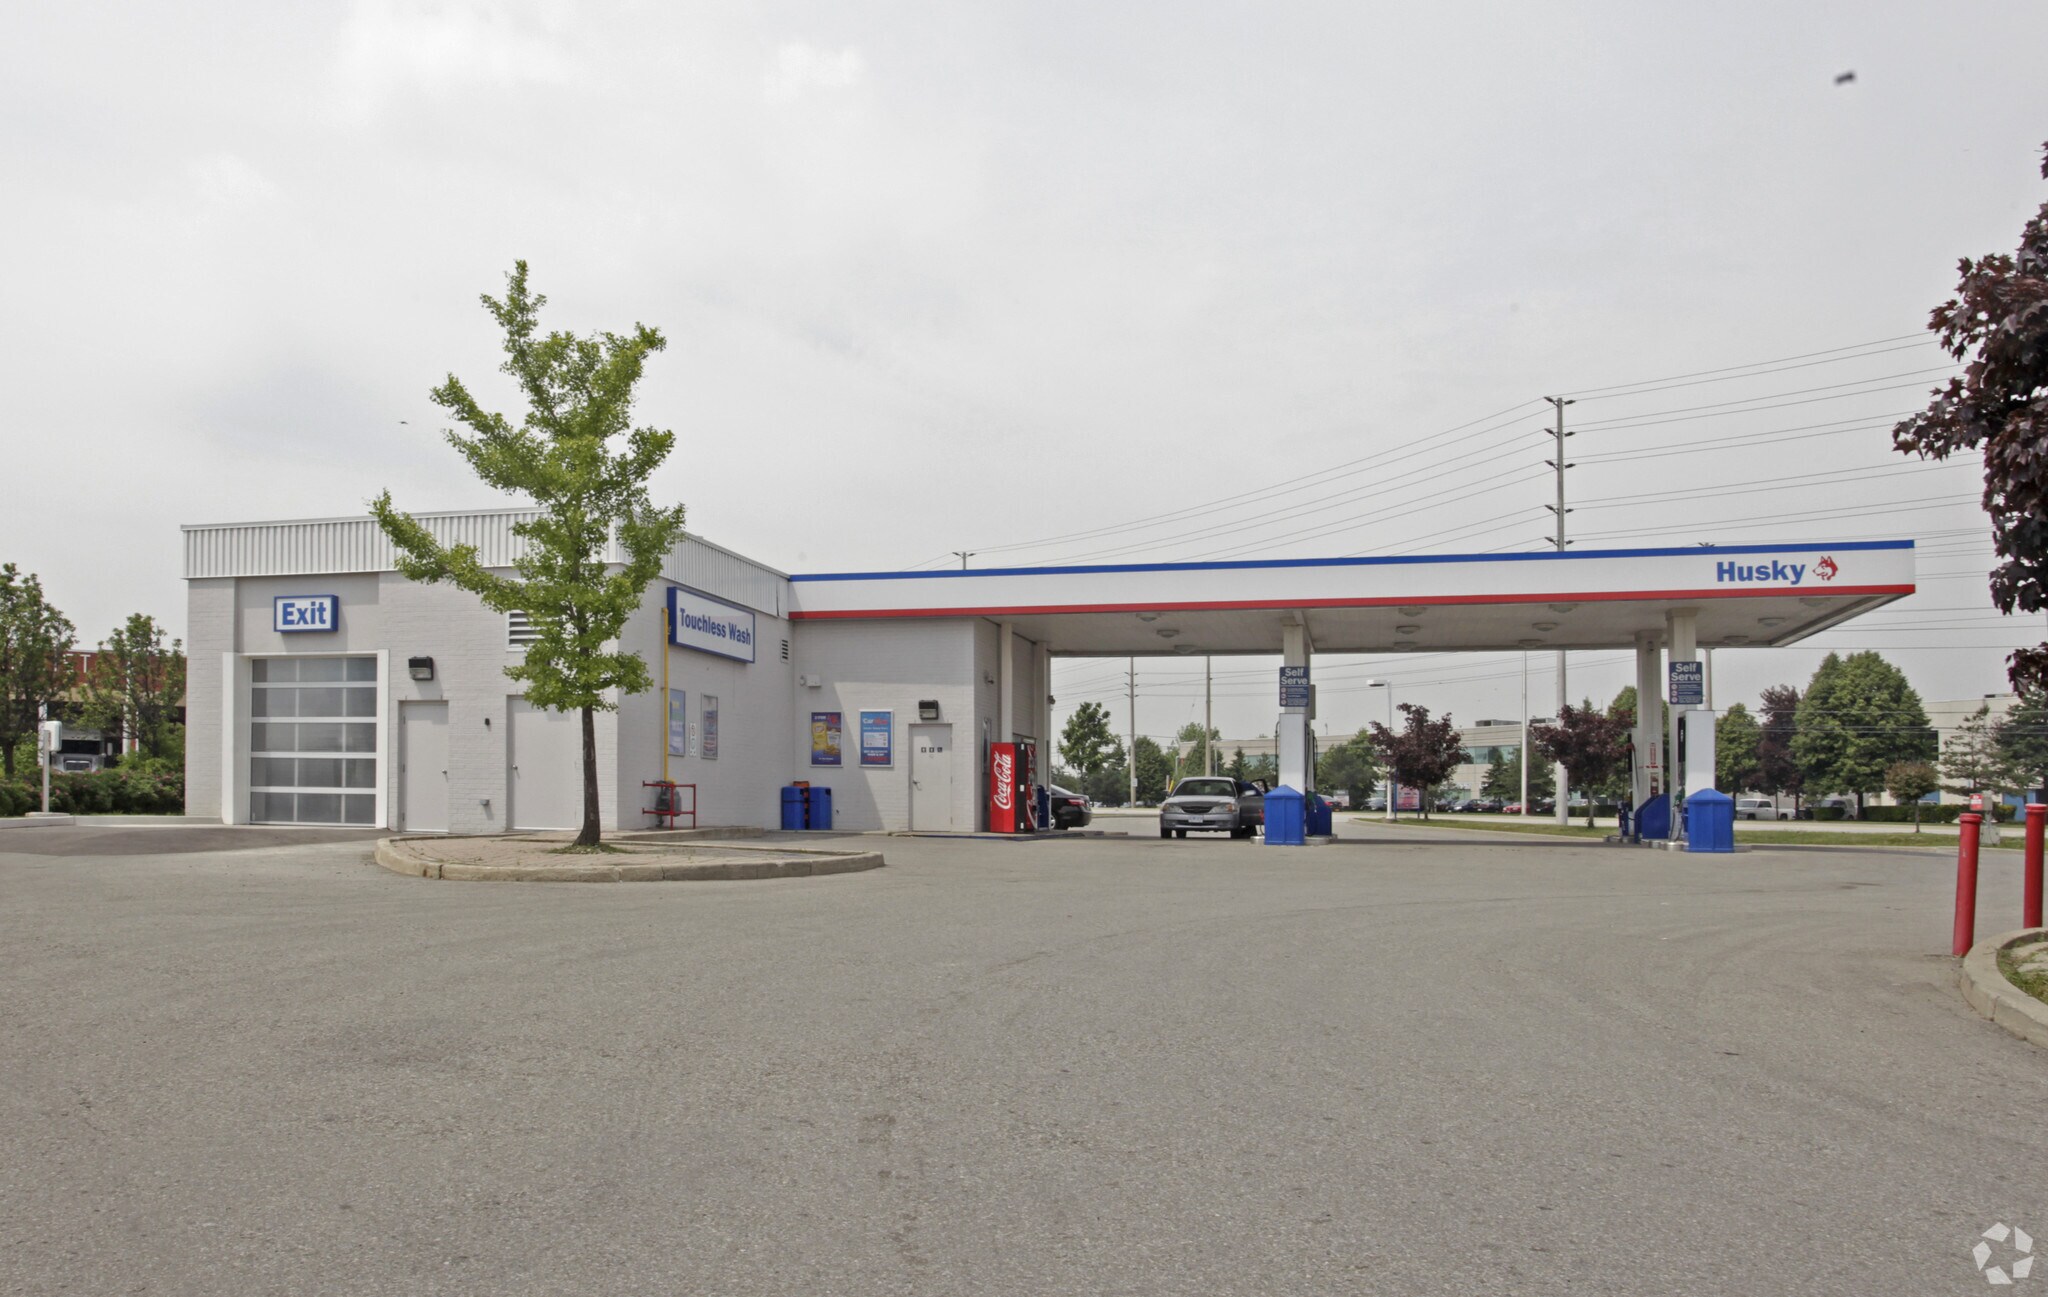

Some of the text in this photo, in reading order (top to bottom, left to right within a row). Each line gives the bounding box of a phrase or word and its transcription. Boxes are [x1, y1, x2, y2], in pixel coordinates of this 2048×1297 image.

[1716, 560, 1806, 585] Husky
[282, 601, 327, 626] Exit
[680, 607, 727, 639] Touchless
[728, 621, 751, 645] Wash
[1285, 667, 1304, 677] Self
[1675, 663, 1698, 673] Self
[1280, 676, 1308, 685] Serve
[1671, 672, 1702, 682] Serve
